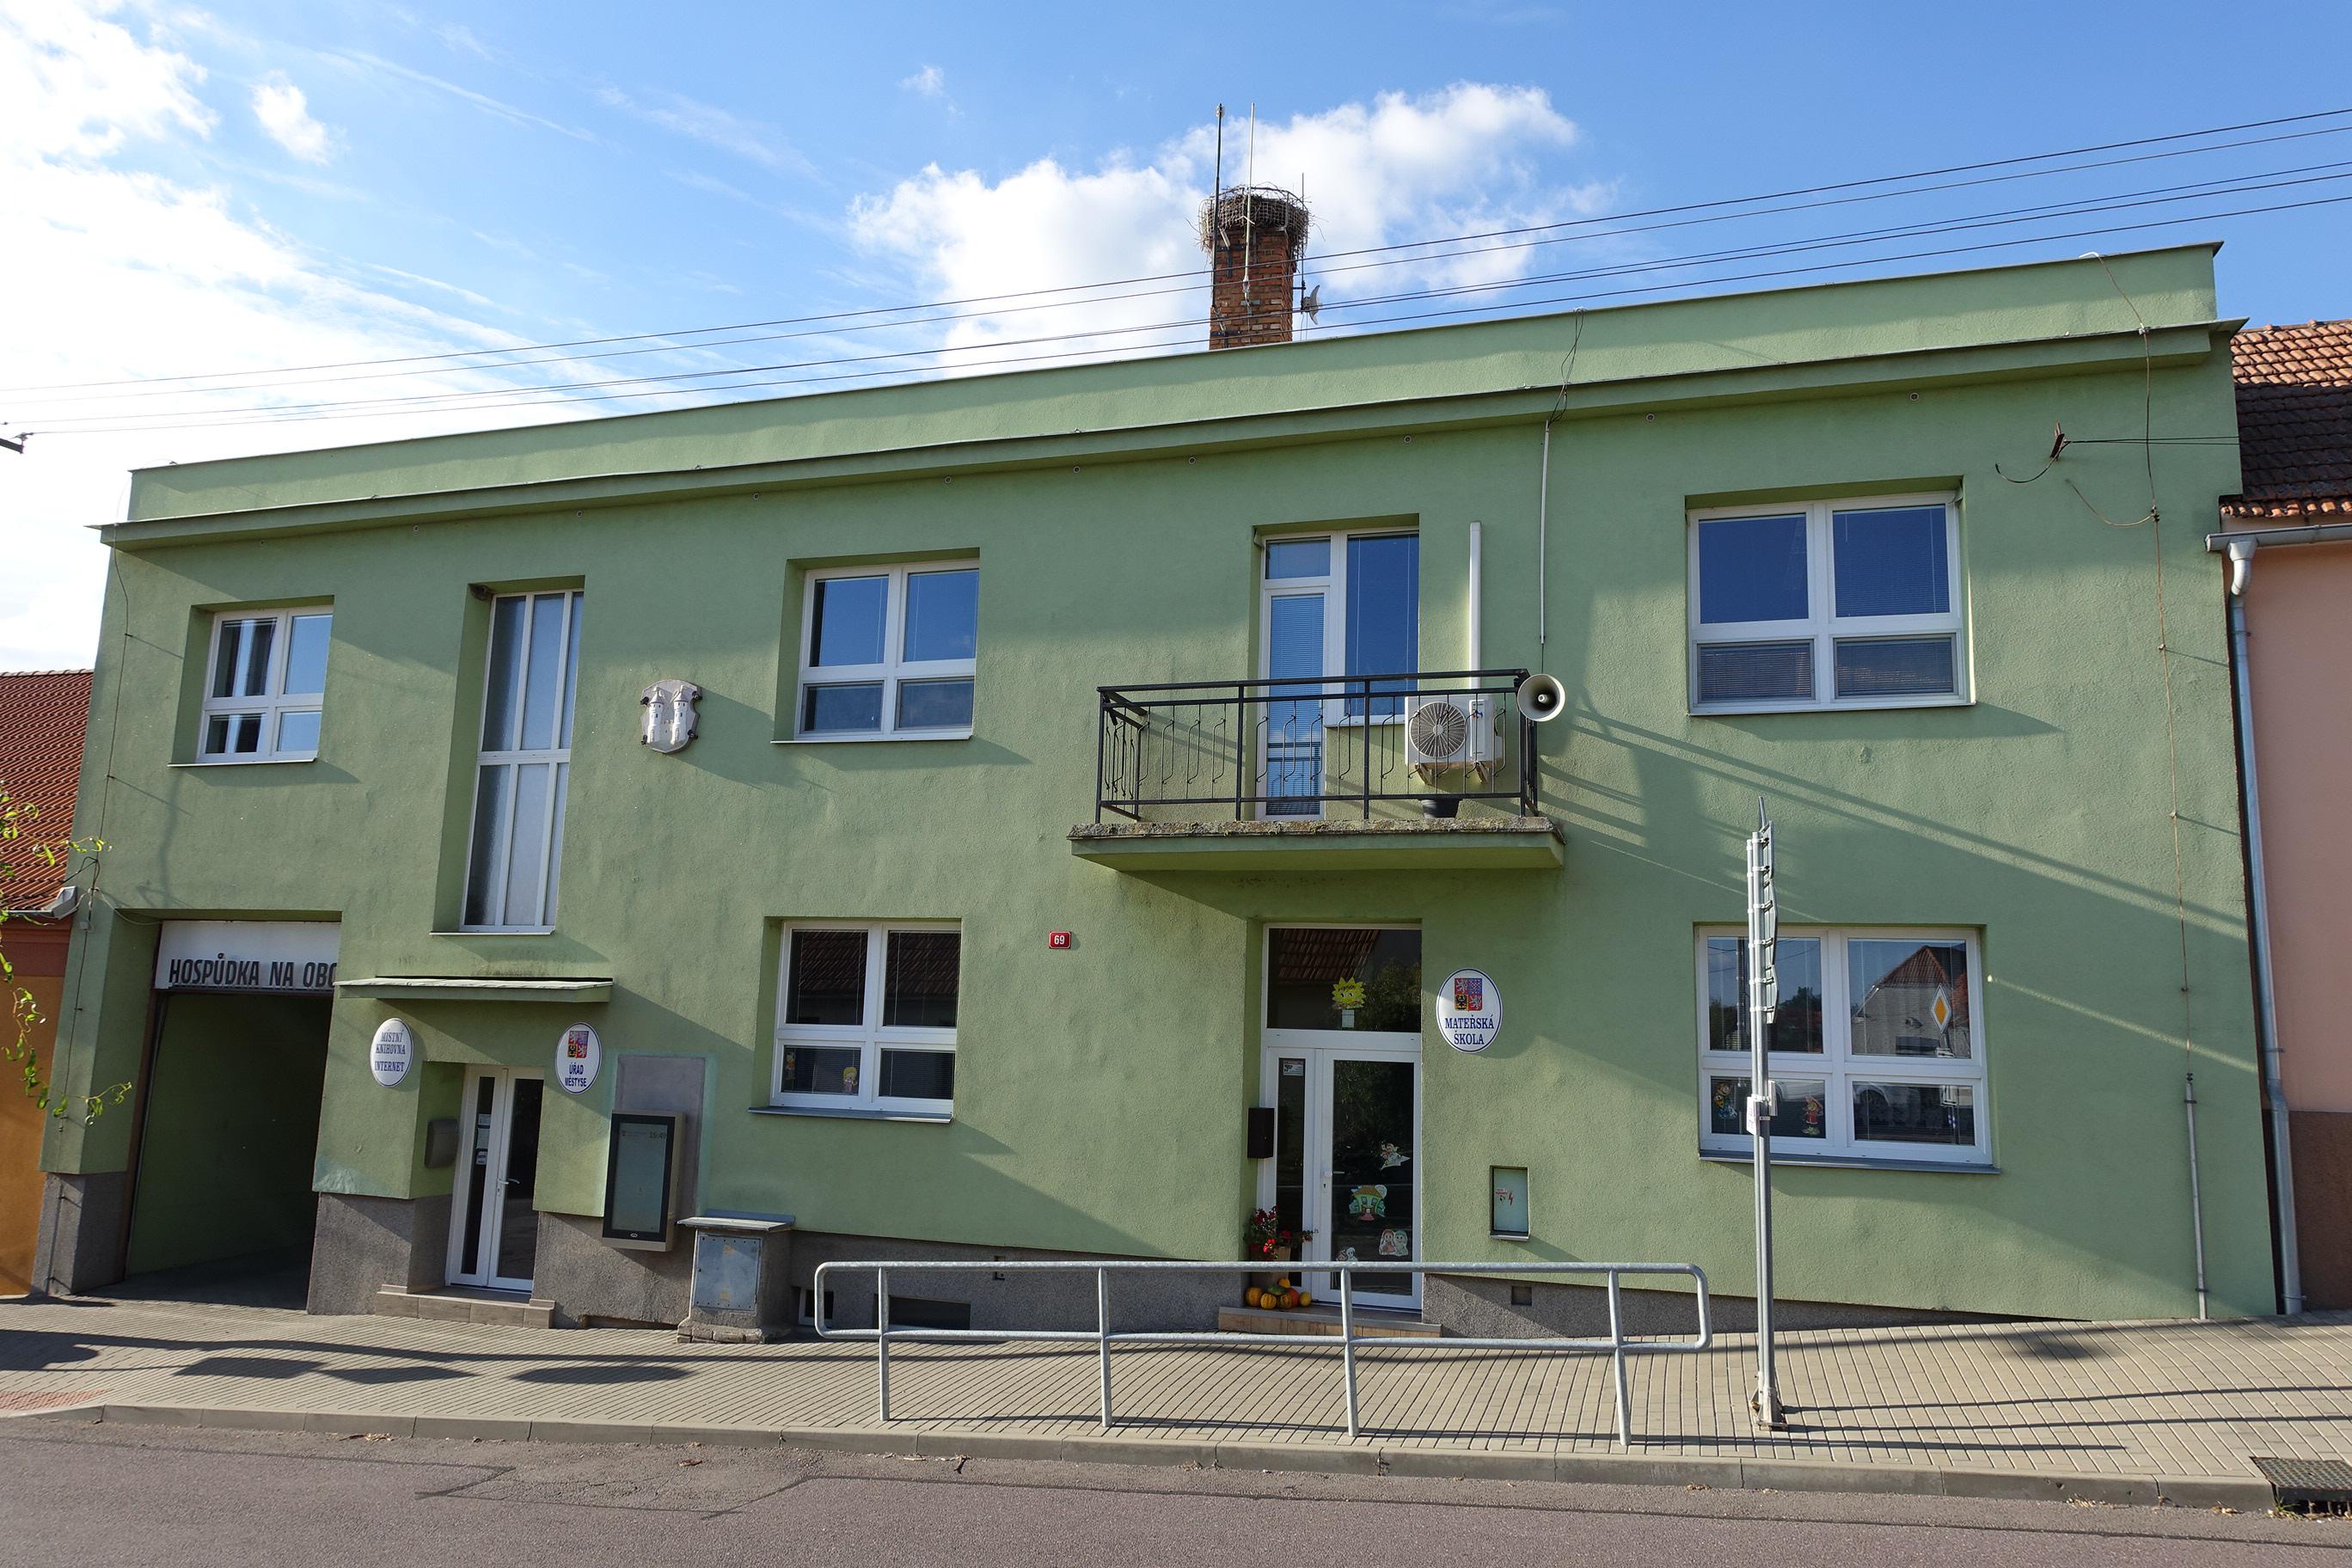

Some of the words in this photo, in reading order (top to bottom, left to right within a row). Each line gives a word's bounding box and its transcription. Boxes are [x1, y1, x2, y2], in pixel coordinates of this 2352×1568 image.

[1054, 934, 1065, 945] 69
[168, 952, 260, 986] HOSPŮDKA
[269, 961, 295, 987] NA
[1445, 1014, 1494, 1030] MATEŘSKÁ
[381, 1029, 404, 1043] MÍSTNÍ
[1454, 1031, 1485, 1045] ŠKOLA
[376, 1044, 406, 1055] KNIHOVNA
[375, 1060, 405, 1072] INTERNET
[569, 1062, 584, 1075] ÚŘAD
[565, 1075, 587, 1087] MĚSTYSE
